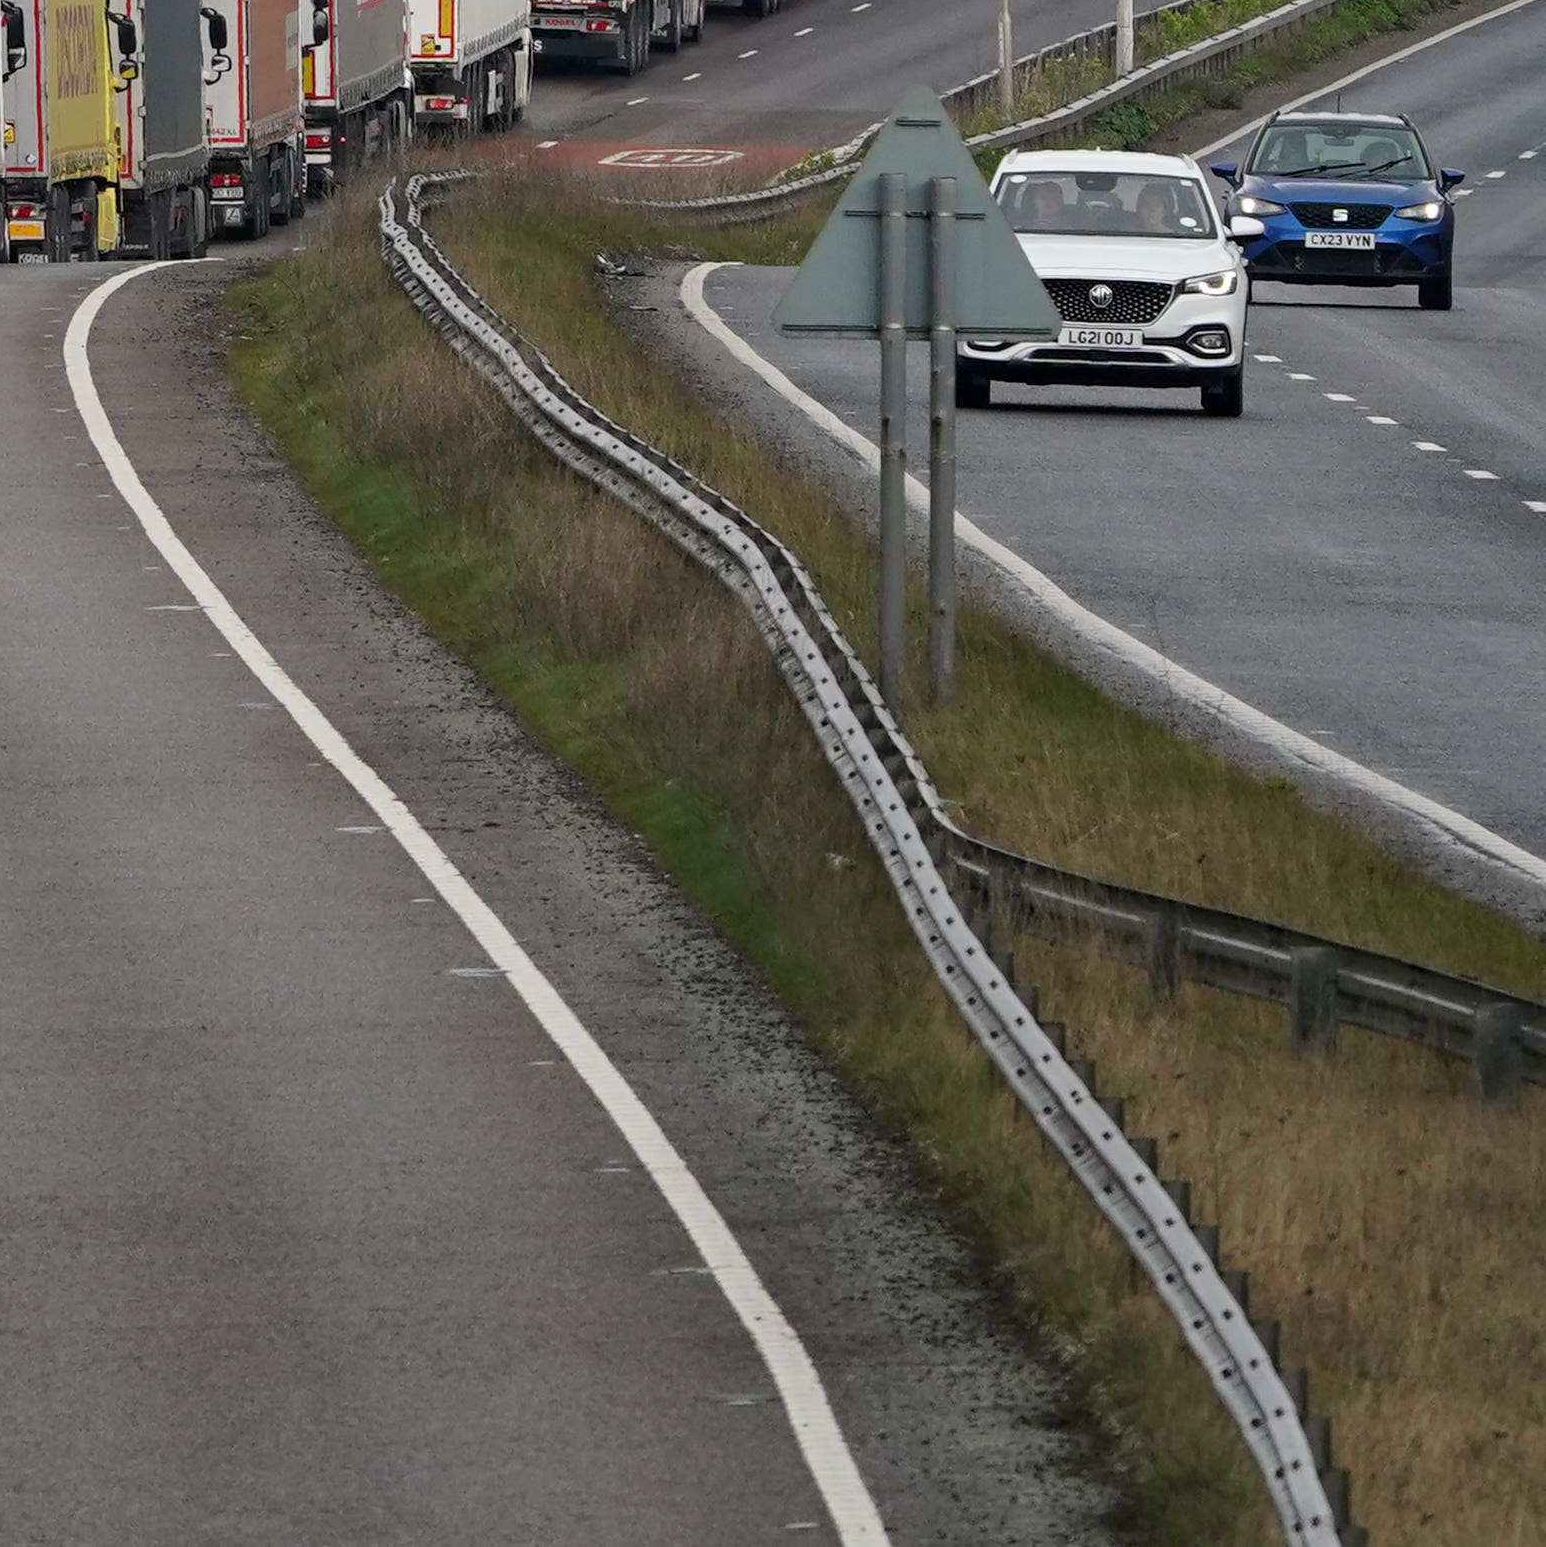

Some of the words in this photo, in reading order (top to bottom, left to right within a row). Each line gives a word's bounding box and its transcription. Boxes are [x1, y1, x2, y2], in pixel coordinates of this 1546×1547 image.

[1311, 234, 1342, 246] CX23
[1347, 235, 1371, 247] VYN
[1068, 330, 1100, 345] LG21
[1104, 331, 1134, 346] OOJ
